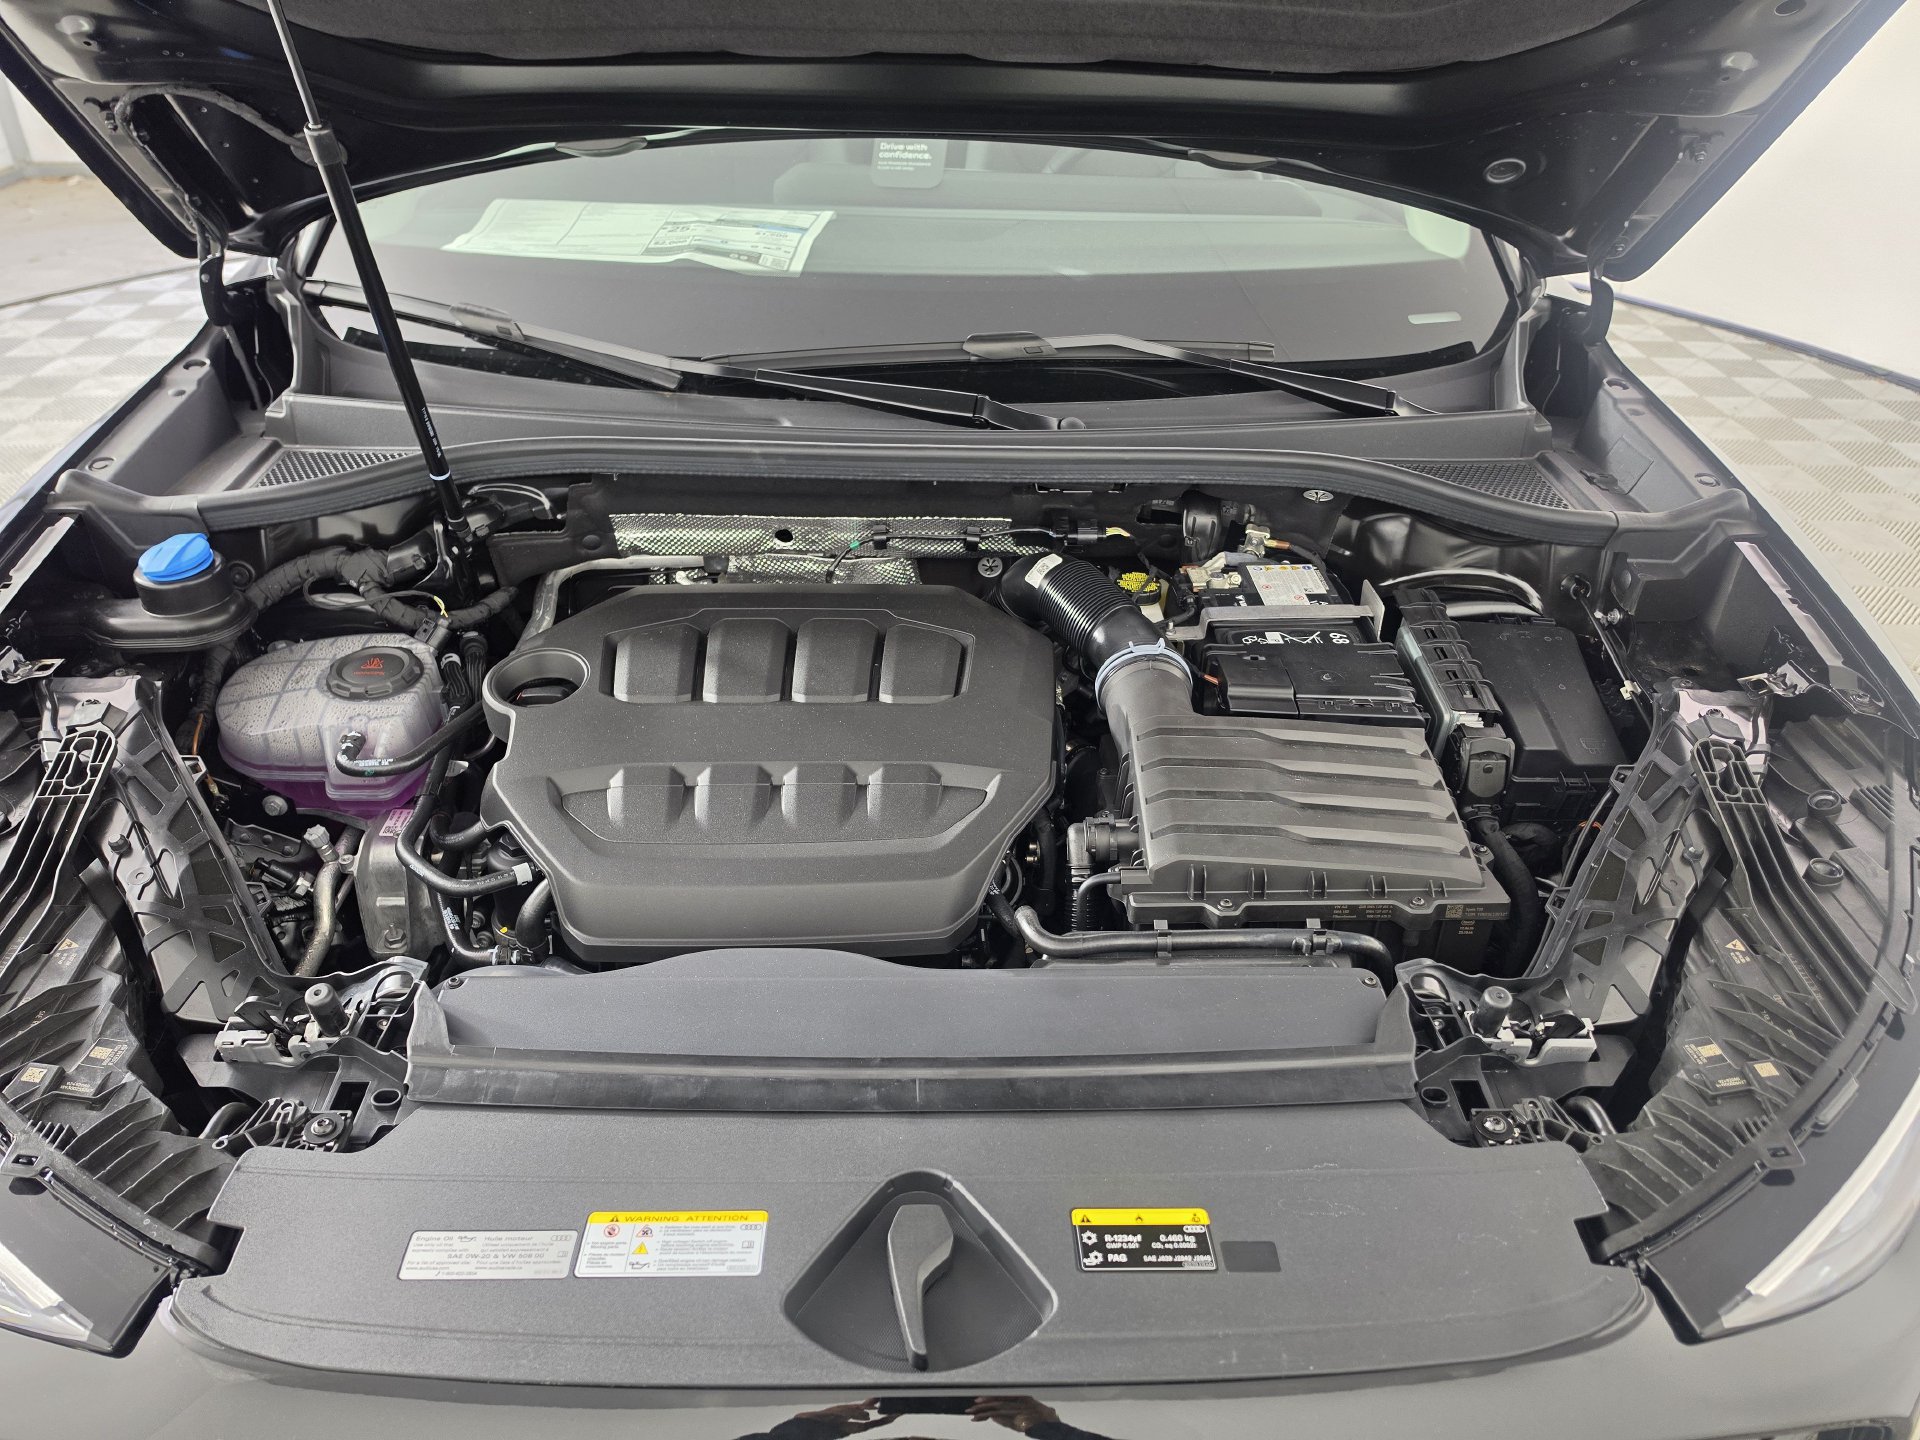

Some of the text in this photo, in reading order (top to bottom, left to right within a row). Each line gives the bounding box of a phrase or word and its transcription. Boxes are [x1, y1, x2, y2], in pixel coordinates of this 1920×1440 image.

[880, 142, 929, 151] Drive with
[878, 151, 932, 160] confidence.
[686, 1214, 749, 1222] ATTENTION
[415, 1235, 441, 1243] Engine
[1104, 1233, 1142, 1243] R-1234yf
[1184, 1234, 1196, 1243] kg
[1107, 1253, 1128, 1262] PAG
